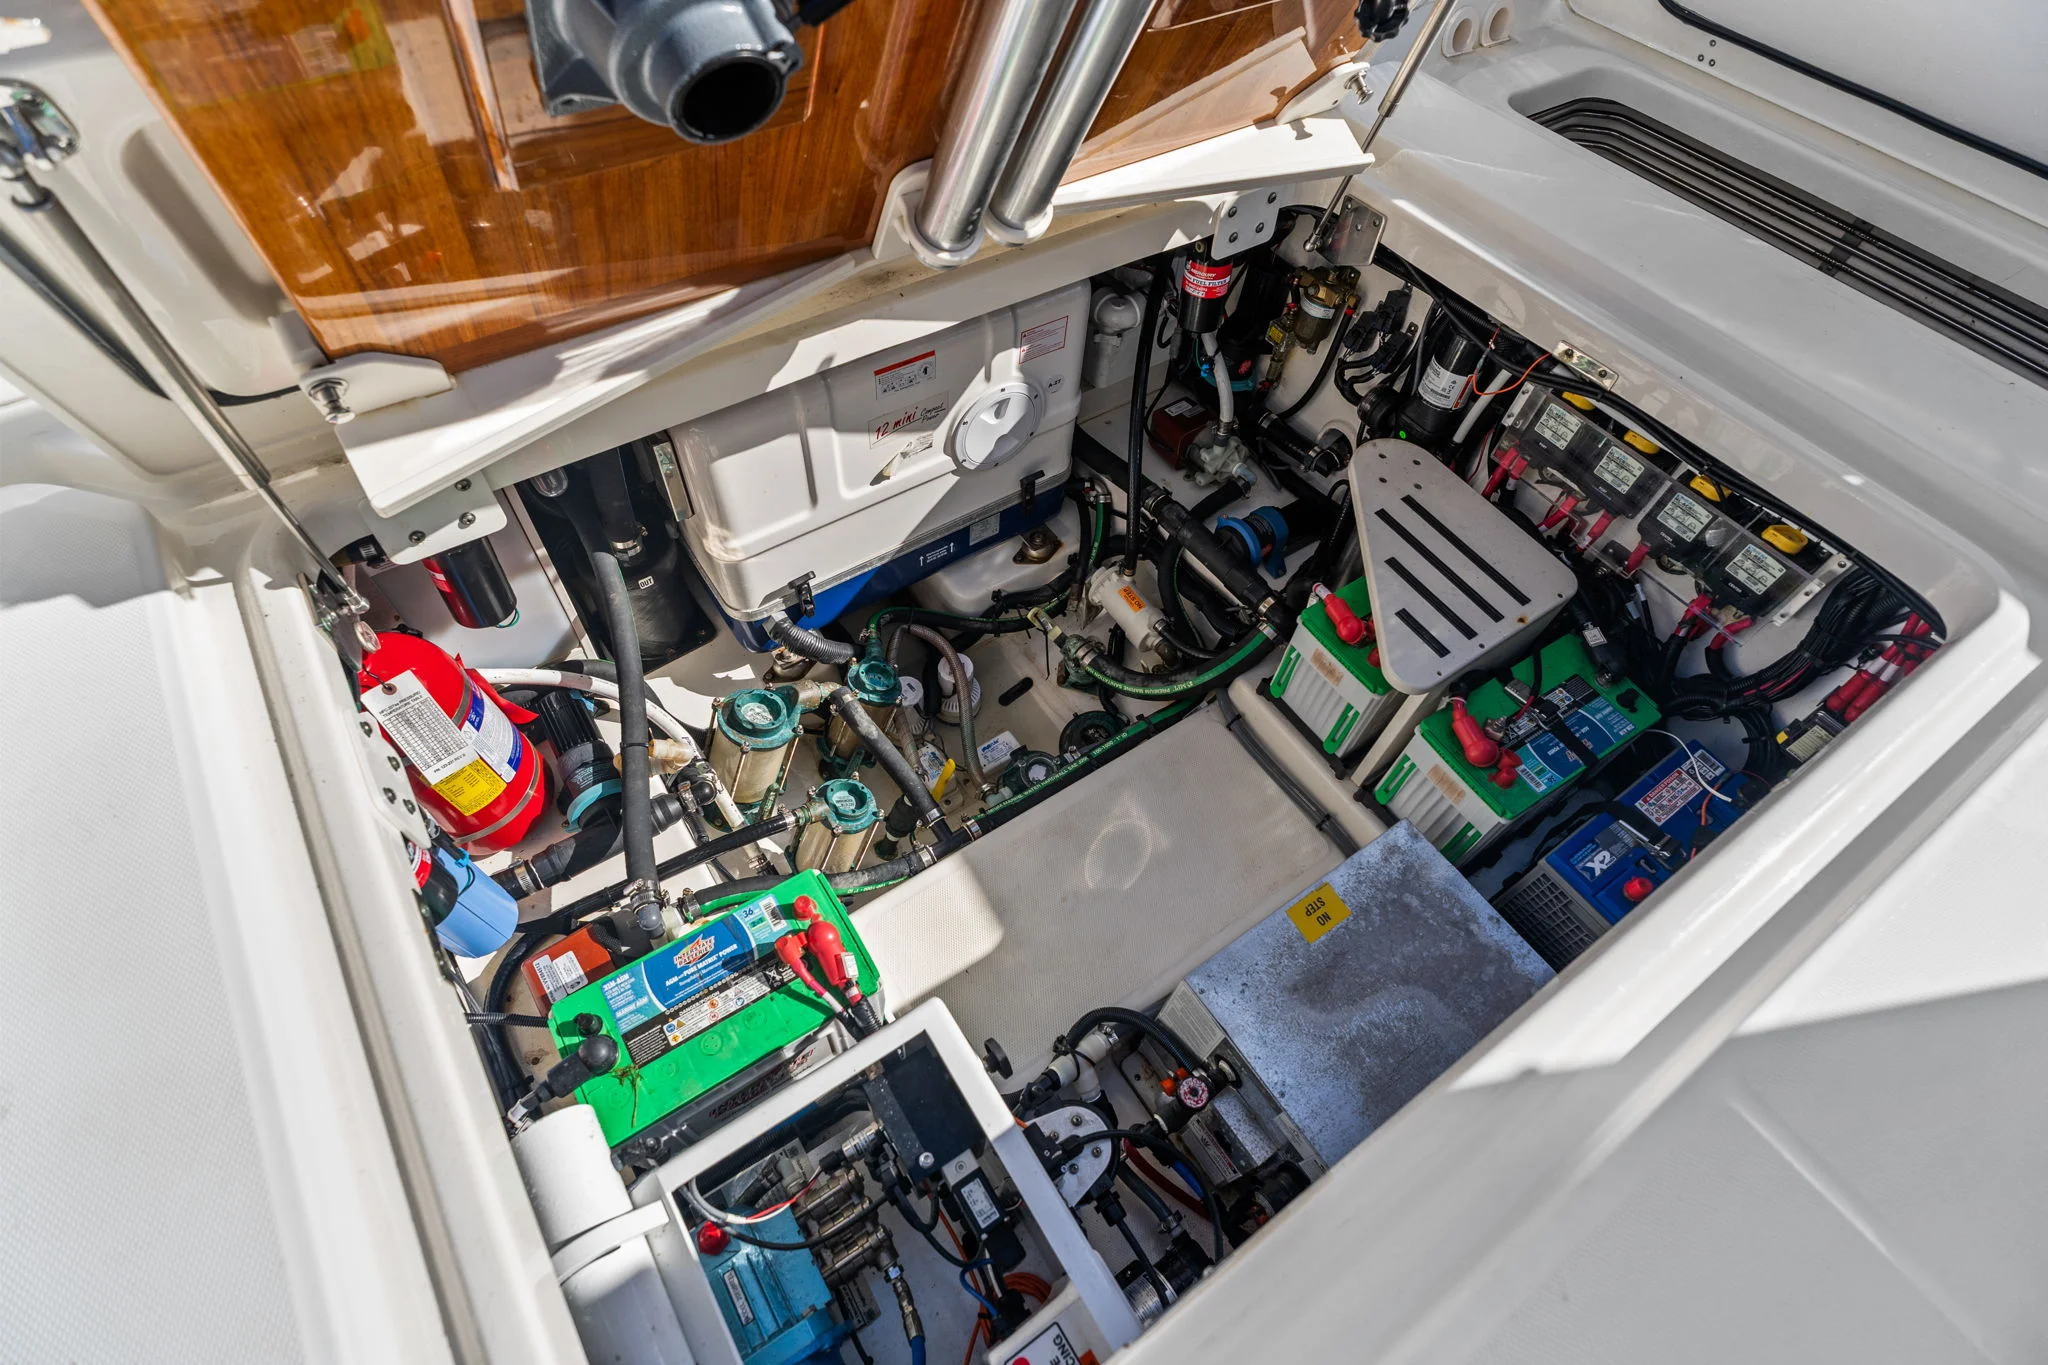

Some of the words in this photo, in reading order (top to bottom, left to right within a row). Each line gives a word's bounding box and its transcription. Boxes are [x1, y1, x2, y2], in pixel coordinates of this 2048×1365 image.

[1192, 277, 1207, 285] FUEL
[1208, 277, 1226, 287] FILTER
[876, 421, 890, 440] 12
[893, 406, 919, 430] mini
[639, 578, 652, 587] OUT
[1122, 685, 1143, 693] MARINE
[1144, 683, 1170, 696] PREMIUM
[1023, 783, 1041, 796] WATER
[1583, 848, 1616, 878] X2
[741, 906, 754, 918] 36
[1305, 896, 1326, 917] STEP
[1316, 911, 1332, 926] NO
[672, 934, 717, 962] INTERSTATE
[676, 941, 717, 969] BATTERIES
[664, 975, 679, 986] AGM
[682, 964, 698, 976] PURE
[718, 943, 738, 957] POWER
